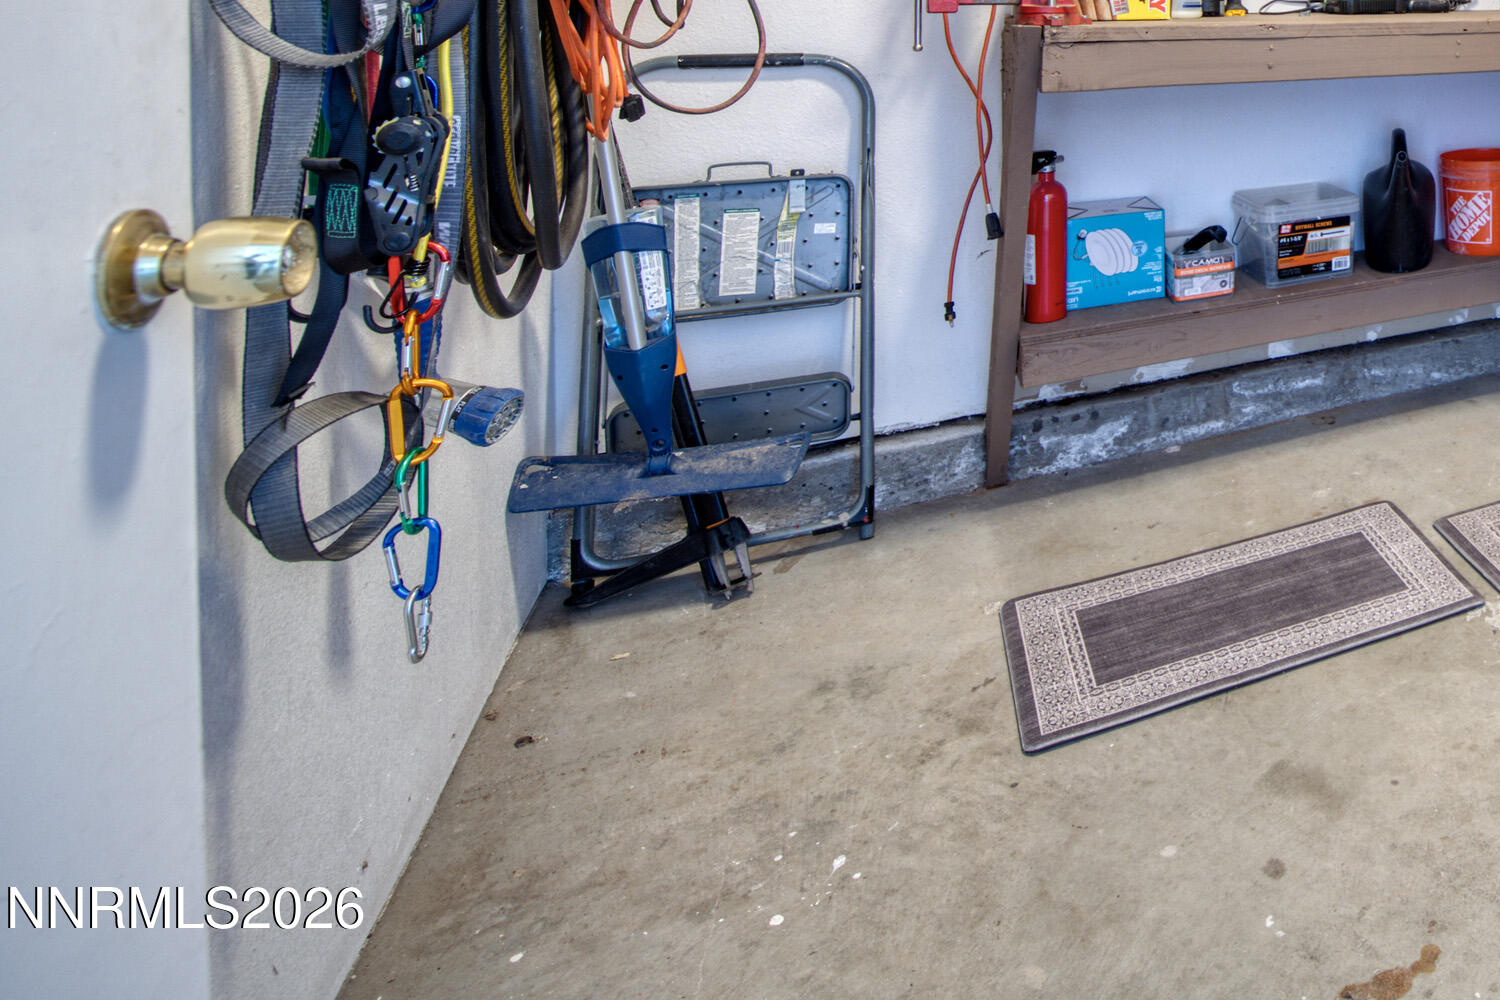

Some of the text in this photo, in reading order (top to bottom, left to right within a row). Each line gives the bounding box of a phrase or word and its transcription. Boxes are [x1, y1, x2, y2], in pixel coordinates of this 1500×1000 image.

[1449, 191, 1491, 241] HOME
[1450, 195, 1467, 216] THE
[1460, 210, 1491, 243] DEPOT
[1190, 256, 1220, 268] CAMO
